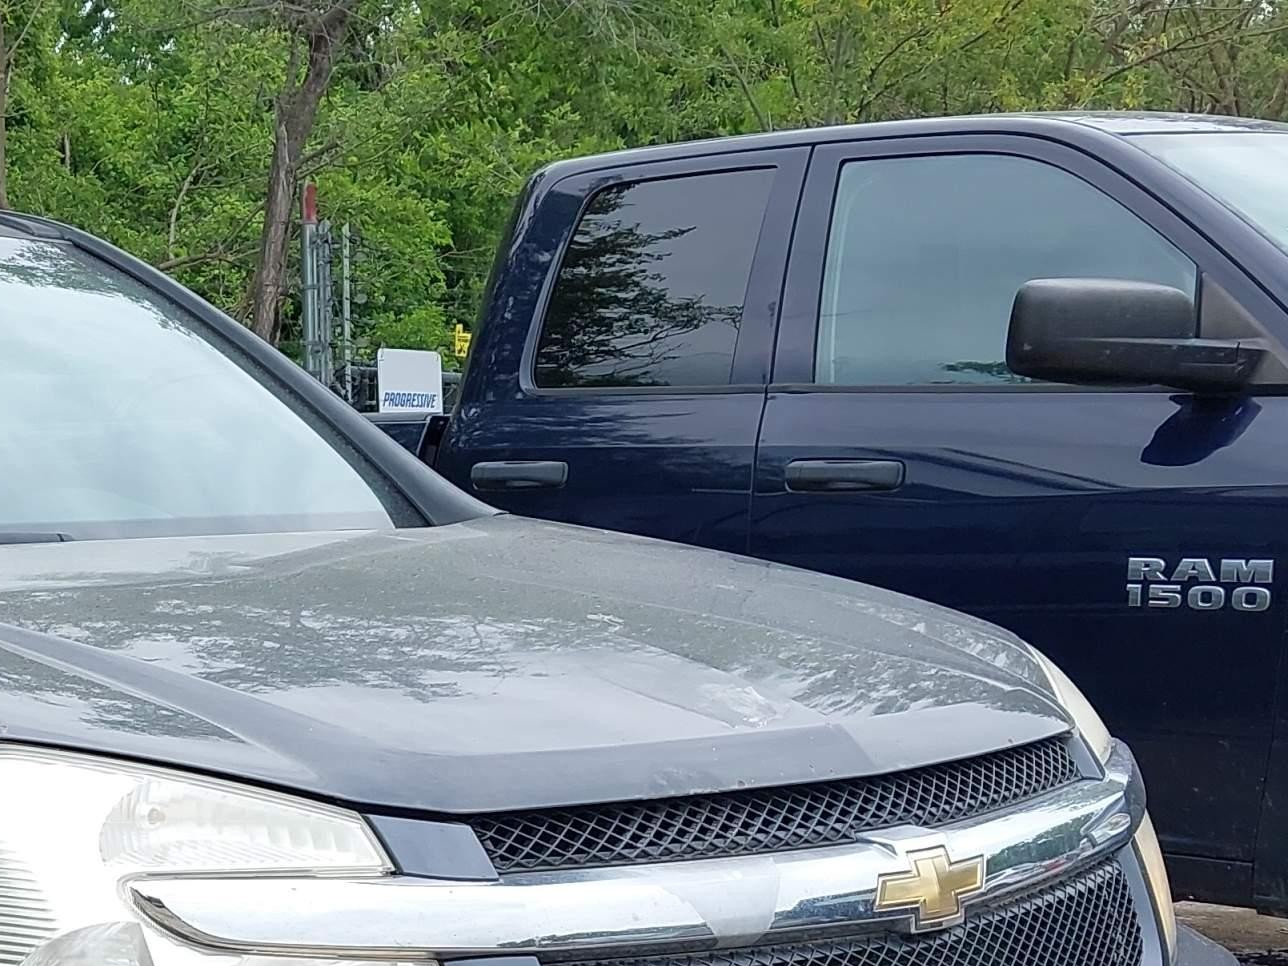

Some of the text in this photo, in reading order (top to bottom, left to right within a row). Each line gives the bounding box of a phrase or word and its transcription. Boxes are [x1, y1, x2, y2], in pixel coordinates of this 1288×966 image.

[383, 392, 437, 408] PROGRESSIVE
[1127, 557, 1274, 583] RAM
[1126, 584, 1272, 611] 1500
